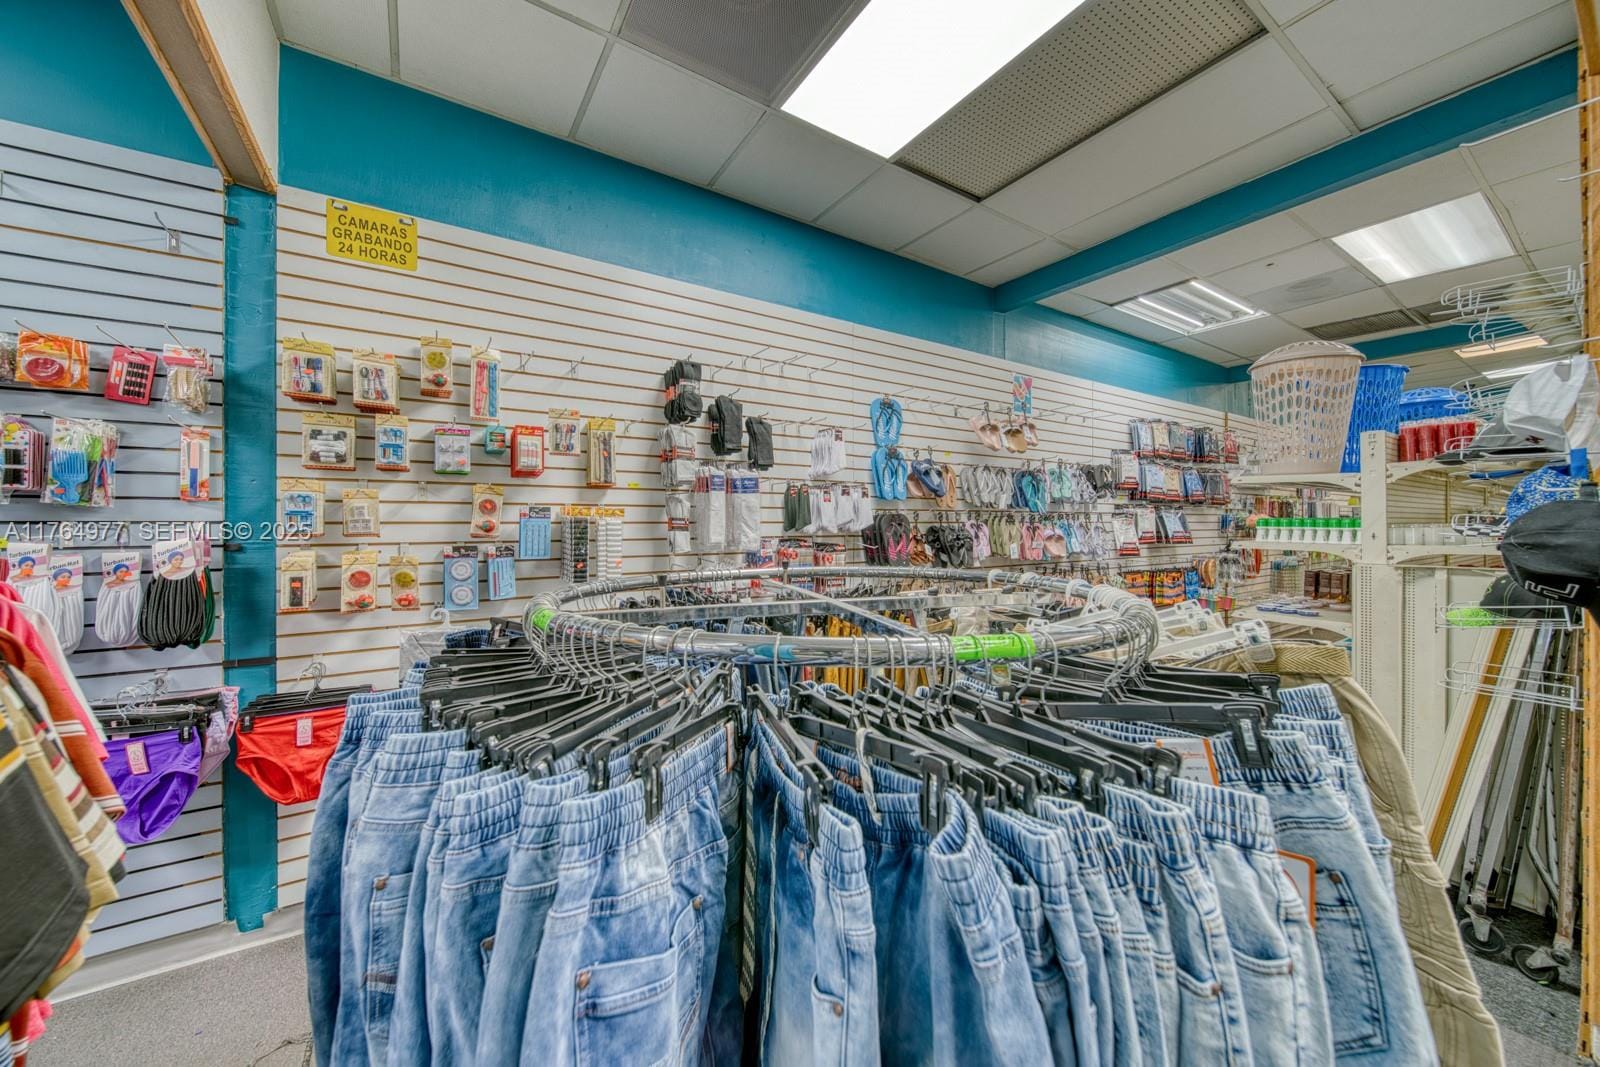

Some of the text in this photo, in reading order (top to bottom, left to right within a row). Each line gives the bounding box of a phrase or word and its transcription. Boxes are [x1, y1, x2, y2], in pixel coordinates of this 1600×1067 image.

[338, 214, 407, 240] CAMARAS
[332, 227, 412, 254] GRABANDO
[338, 241, 407, 265] 24 HORAS
